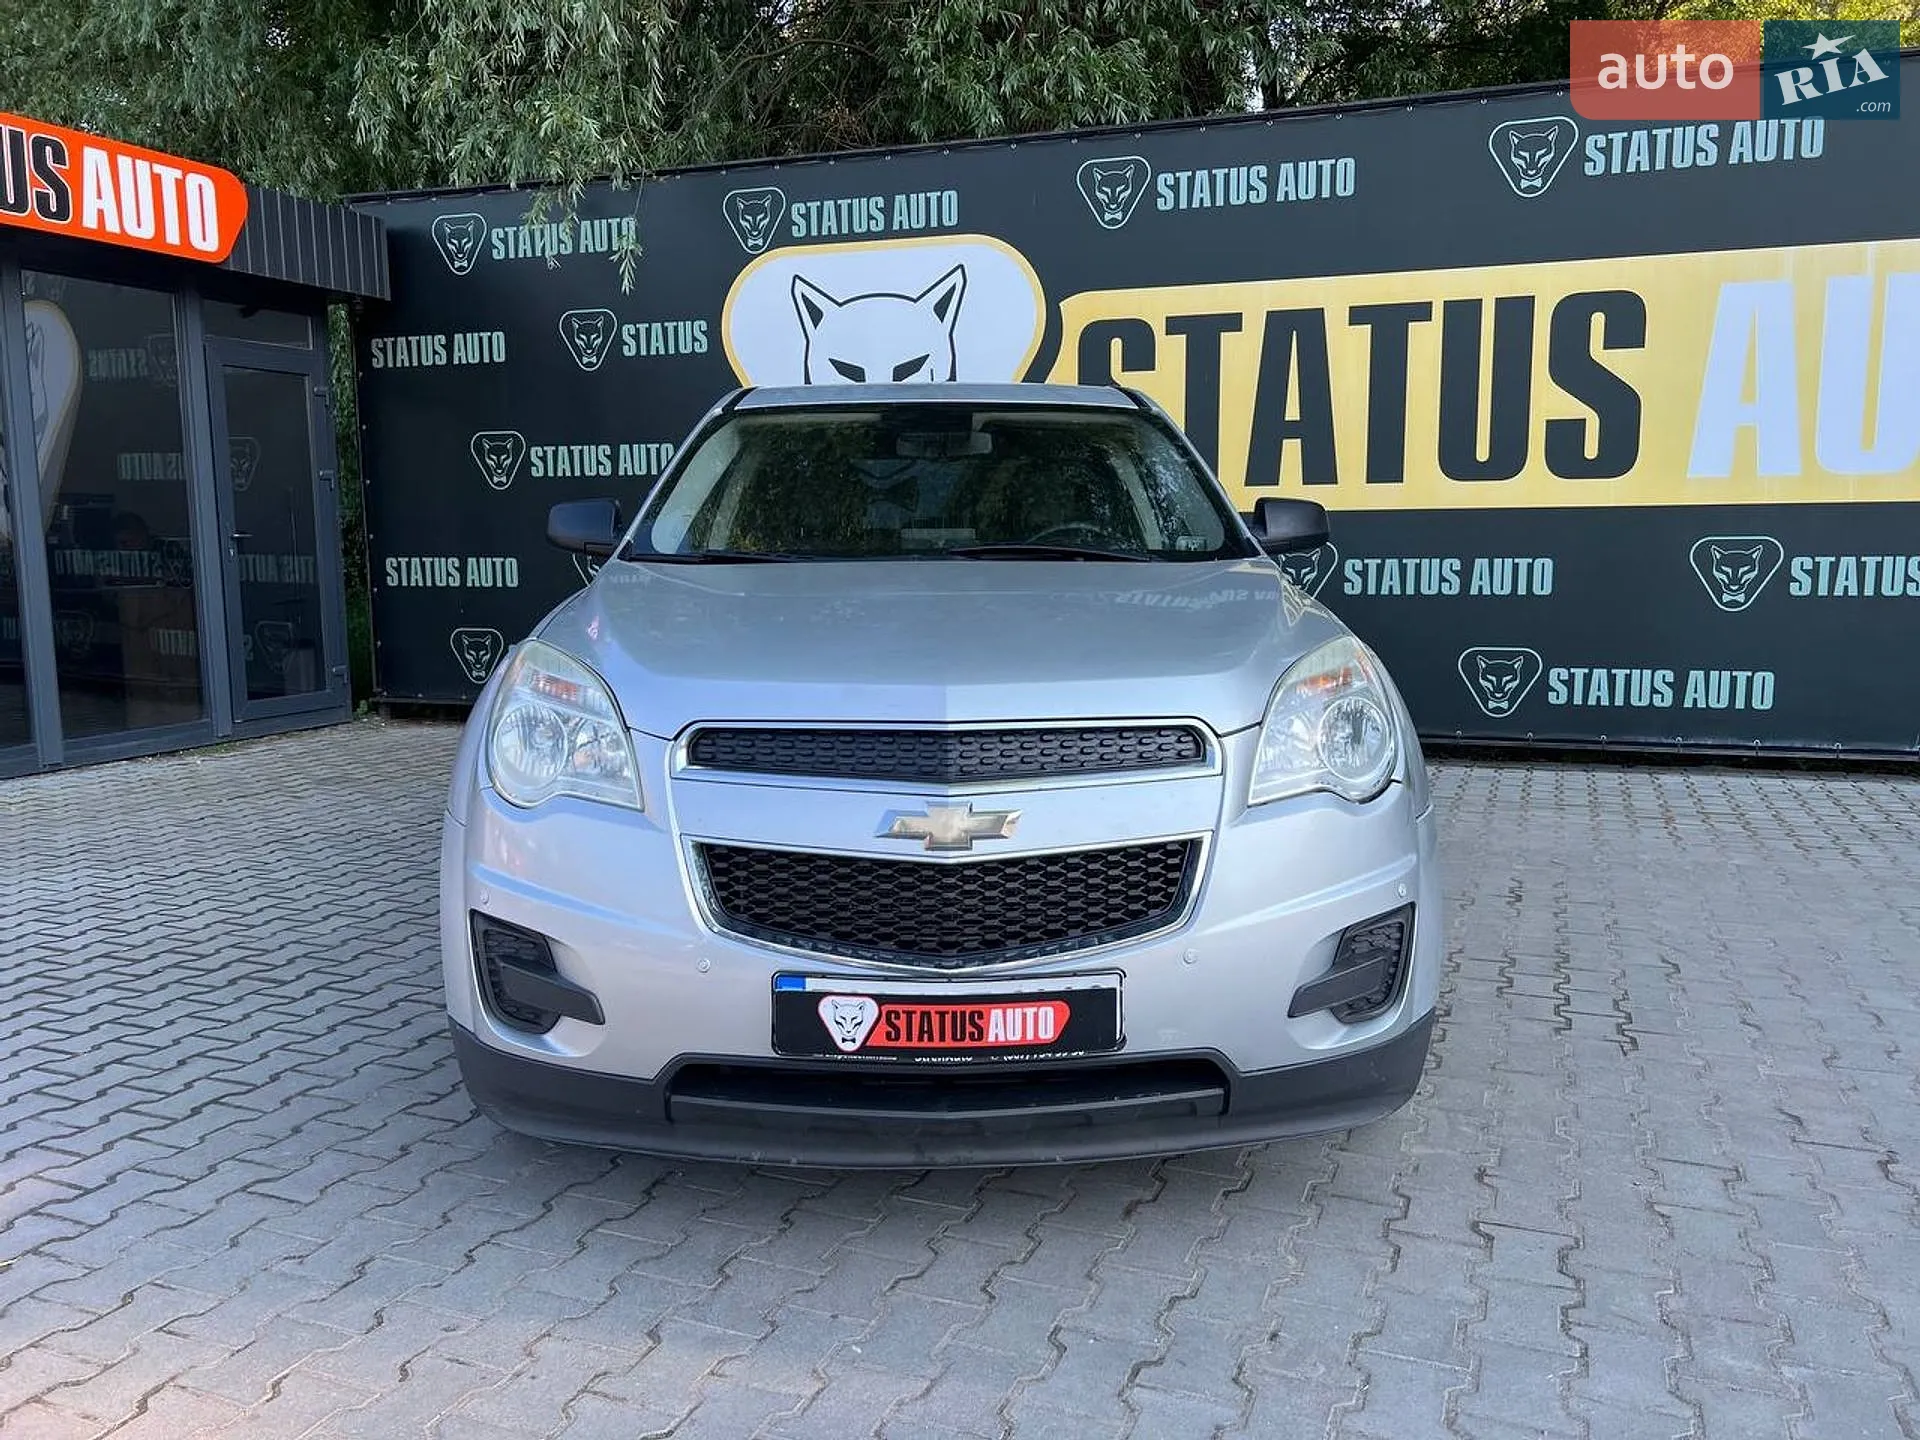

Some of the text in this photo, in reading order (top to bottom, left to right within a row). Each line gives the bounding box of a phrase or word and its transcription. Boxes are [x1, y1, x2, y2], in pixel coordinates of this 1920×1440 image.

[1583, 116, 1826, 177] STATUS AUTO
[82, 146, 219, 252] AUTO
[1156, 157, 1357, 212] STATUS AUTO
[791, 190, 959, 238] STATUS AUTO
[491, 217, 637, 261] STATUS AUTO
[371, 331, 506, 369] STATUS AUTO
[623, 320, 708, 357] STATUS
[1687, 272, 1920, 478] AU
[530, 445, 612, 478] STATUS
[385, 557, 519, 588] STATUS AUTO
[1343, 558, 1554, 596] STATUS AUTO
[1789, 555, 1920, 597] STATUS
[1548, 667, 1775, 711] STATUS AUTO
[885, 1006, 1055, 1043] STATUS AUTO
